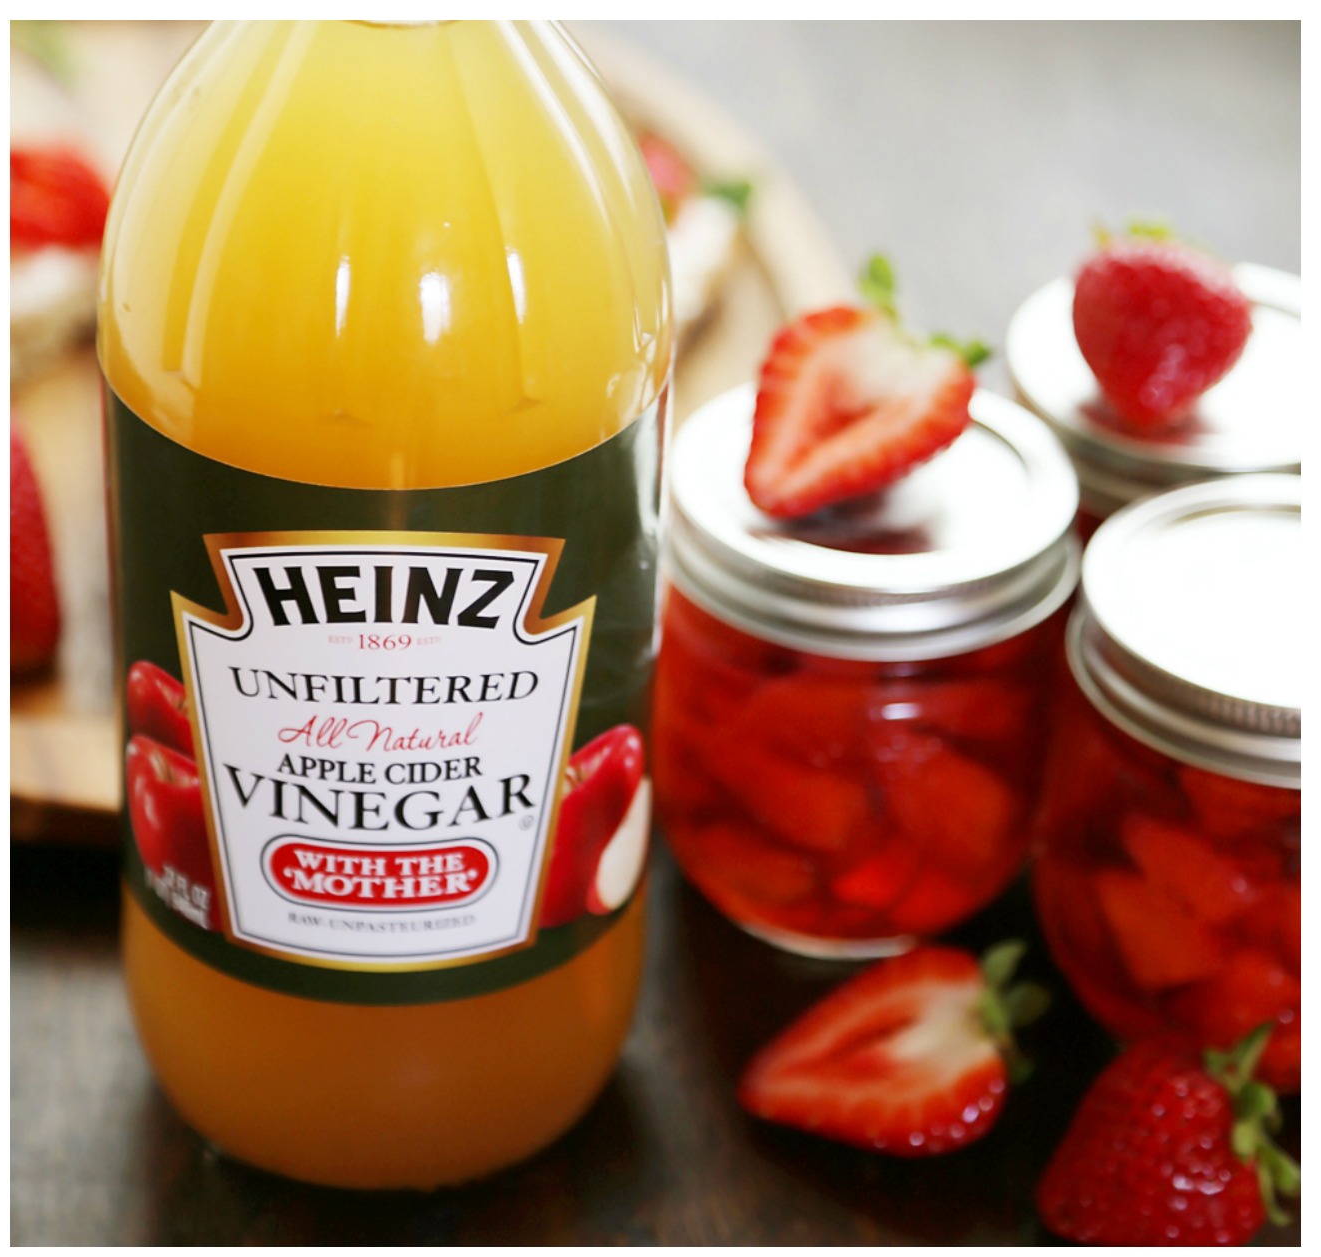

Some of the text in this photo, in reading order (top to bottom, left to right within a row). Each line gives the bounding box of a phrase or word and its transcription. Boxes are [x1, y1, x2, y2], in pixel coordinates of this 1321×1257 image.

[252, 566, 515, 629] HEINZ
[359, 634, 412, 650] 1869
[228, 666, 539, 705] UNFILTERED
[278, 712, 484, 751] All Natural
[277, 753, 483, 785] APPLE CIDER
[223, 763, 535, 831] VINEGAR
[293, 849, 465, 876] WITH THE
